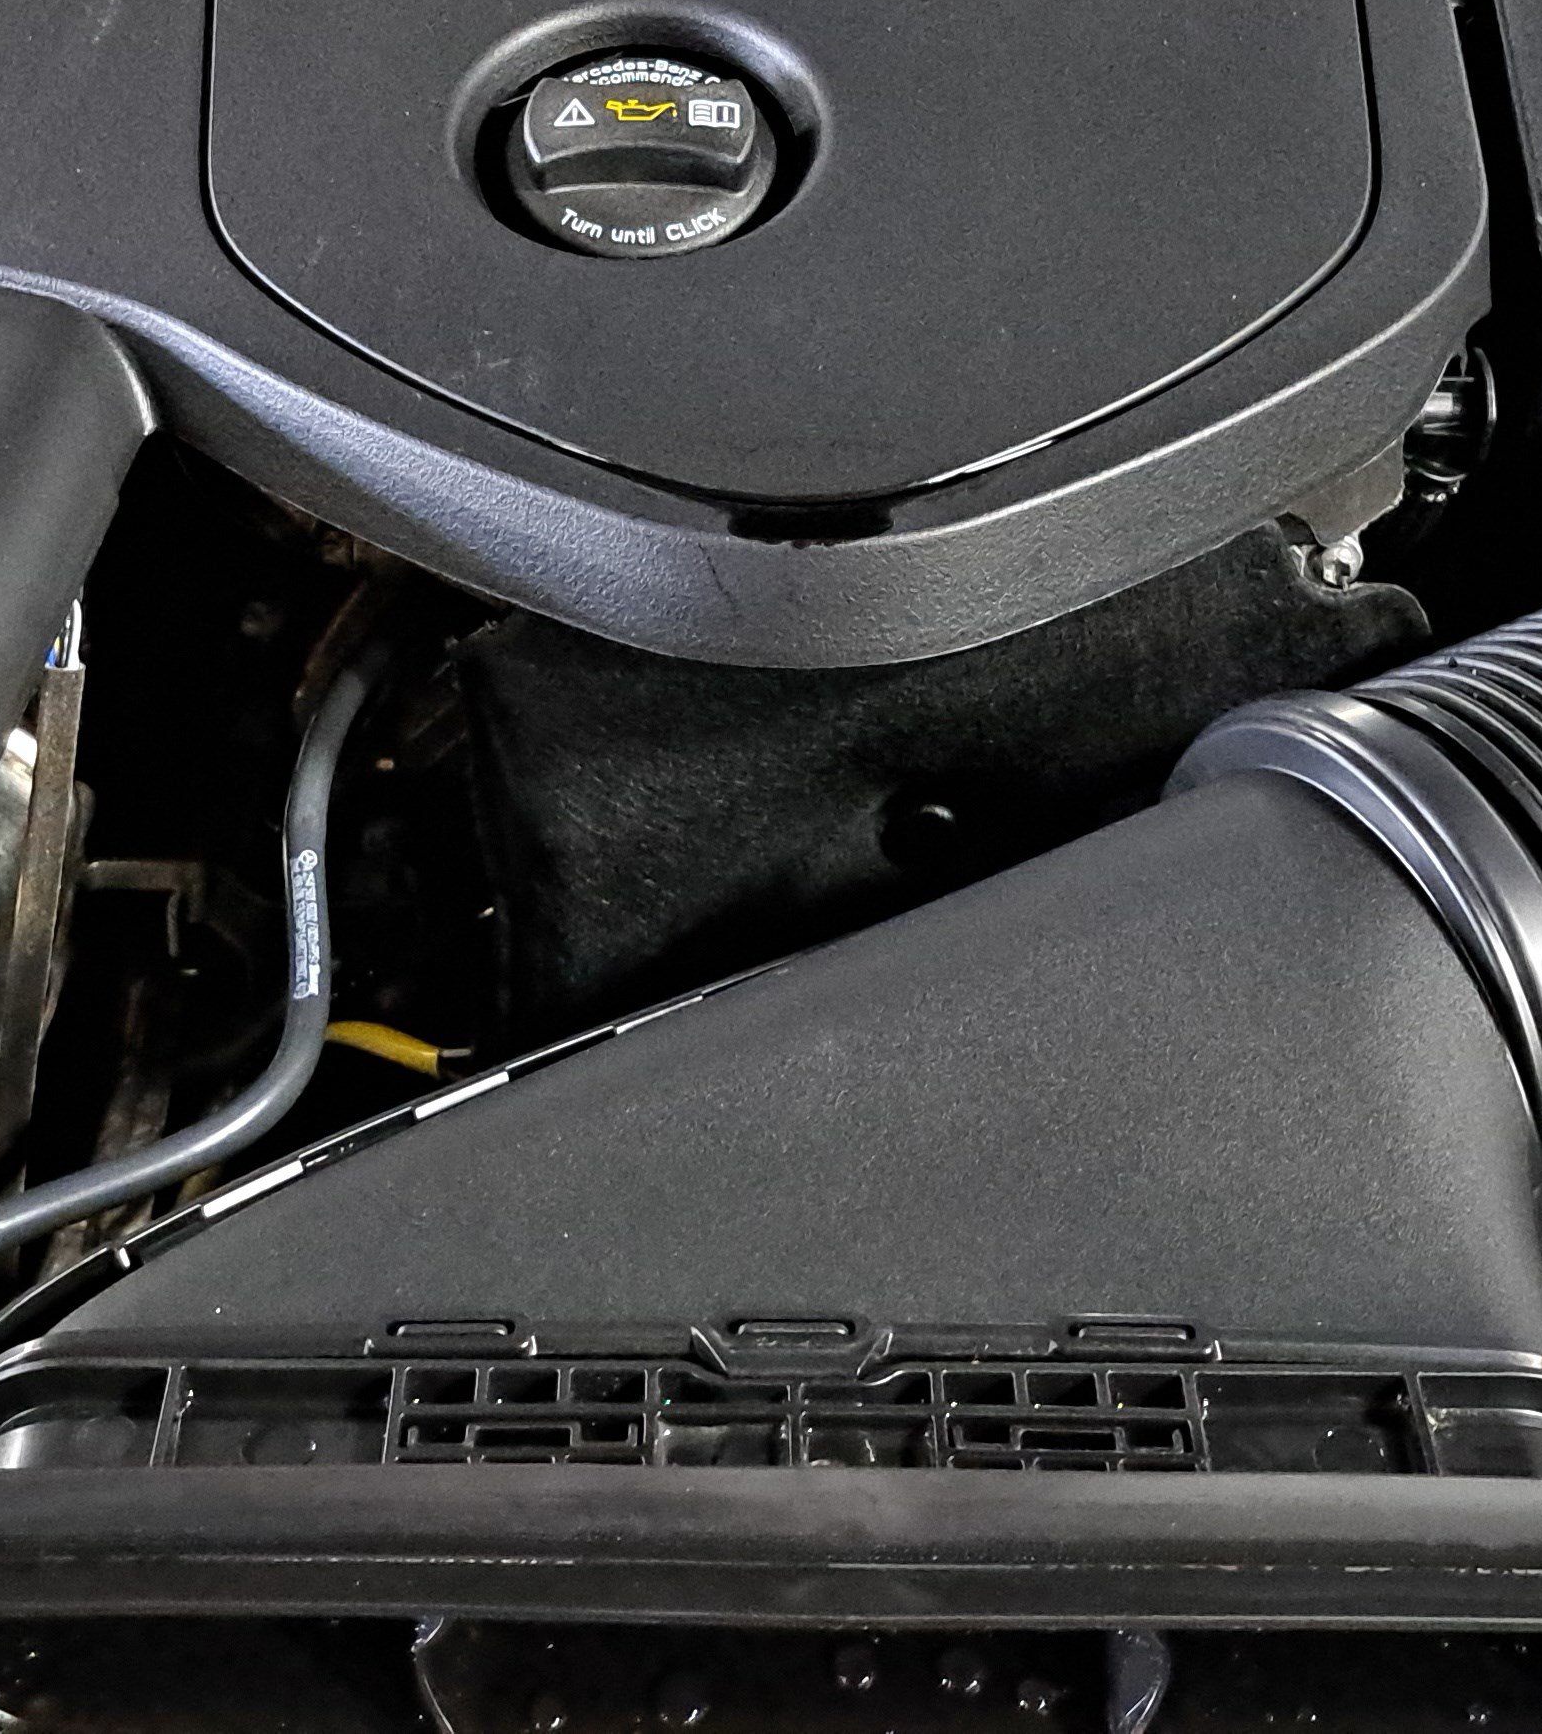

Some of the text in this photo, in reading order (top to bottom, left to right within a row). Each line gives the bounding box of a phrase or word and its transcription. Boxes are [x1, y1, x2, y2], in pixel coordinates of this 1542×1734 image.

[561, 59, 703, 84] ercedes-Benz
[561, 207, 727, 245] Turn until CLICK
